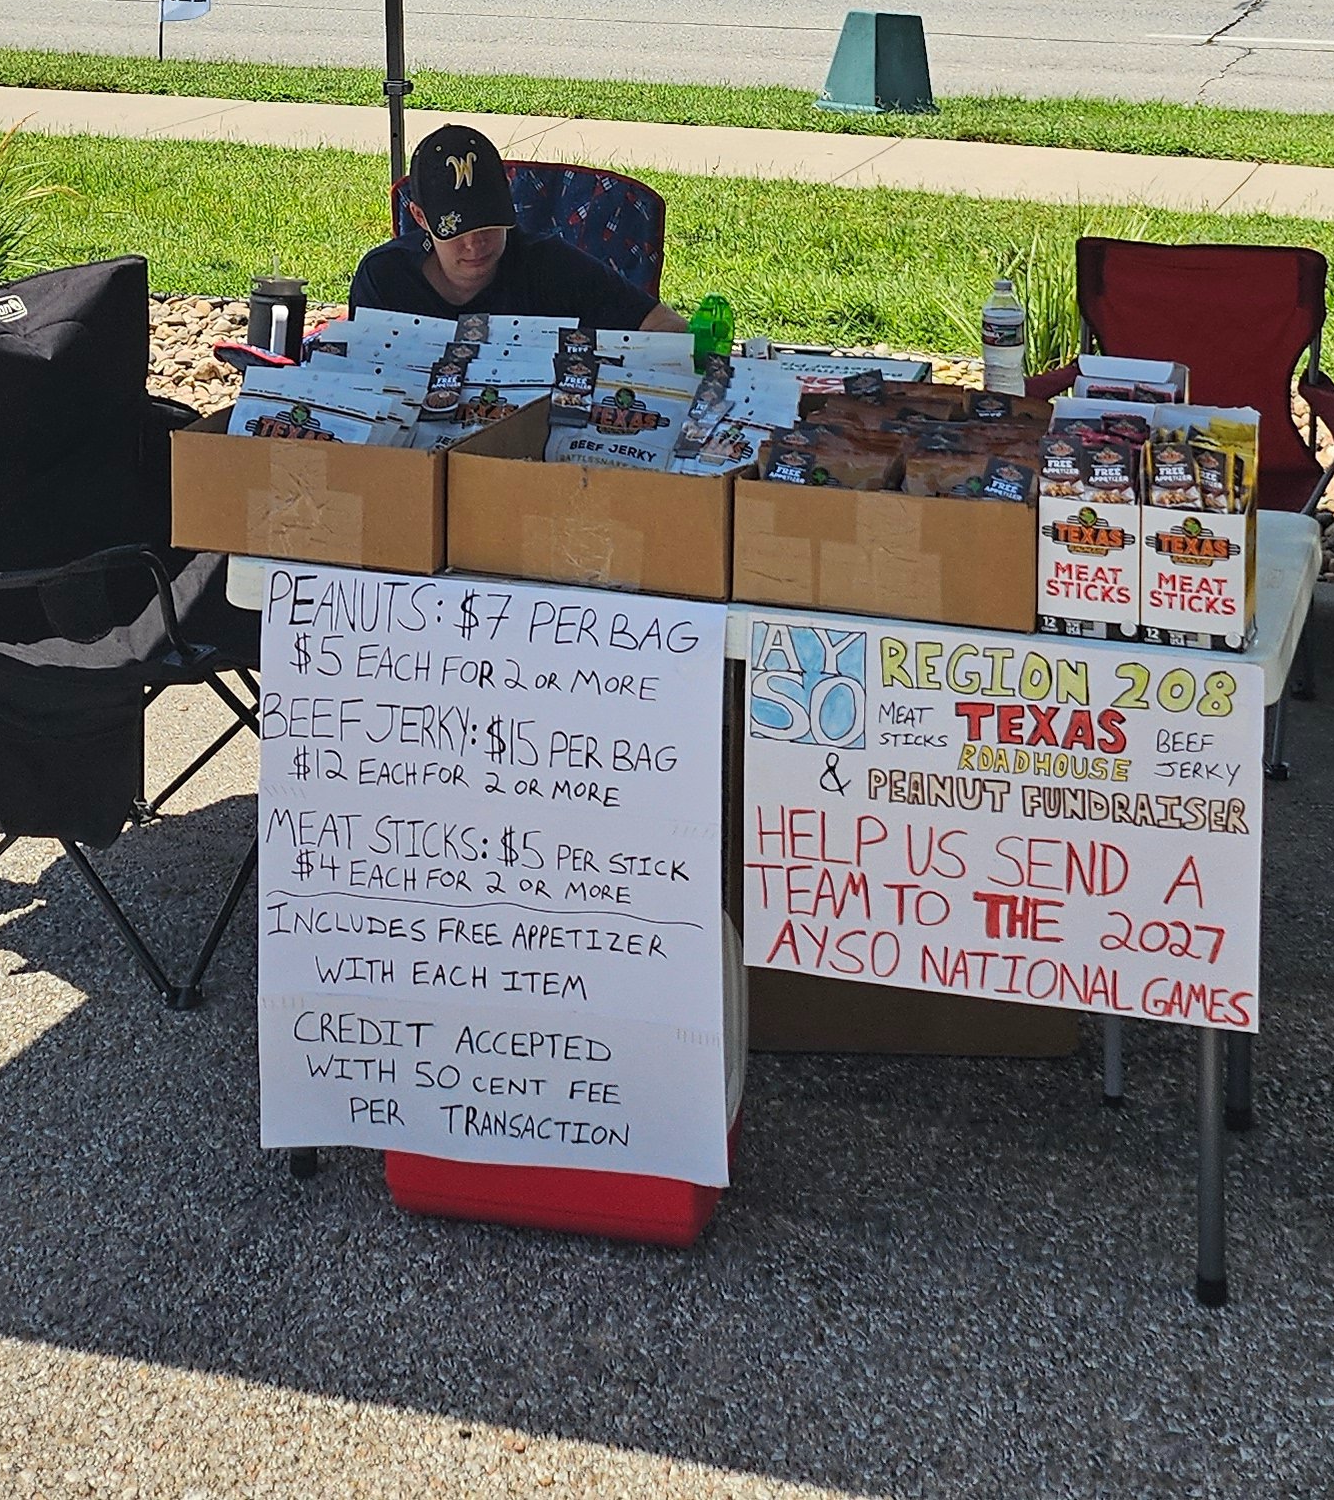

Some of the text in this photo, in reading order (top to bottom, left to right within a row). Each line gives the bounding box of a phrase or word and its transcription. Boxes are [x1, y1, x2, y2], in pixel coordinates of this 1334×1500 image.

[445, 151, 478, 190] W
[569, 440, 657, 463] BEEF JERKY
[1047, 459, 1073, 469] FREE
[776, 466, 802, 478] FREE
[992, 480, 1019, 494] FREE
[1042, 466, 1079, 476] APPETIZER
[1088, 474, 1129, 484] APPETIZER
[1094, 467, 1122, 477] FREE
[1154, 473, 1193, 483] APPETIZER
[1159, 466, 1185, 476] FREE
[1056, 523, 1123, 547] TEXAS
[1159, 534, 1229, 557] TEXAS
[1054, 561, 1123, 585] MEAT
[1157, 571, 1228, 596] MEAT
[1046, 579, 1131, 604] STICKS
[1149, 589, 1236, 616] STICKS
[267, 570, 700, 653] PEANUTS: $7 PER BAG
[1043, 616, 1056, 627] 12
[754, 621, 866, 675] AY
[1146, 627, 1159, 638] 12
[288, 632, 660, 701] $5 EACH FOR 2 OR MORE
[878, 636, 1238, 718] REGION 208
[750, 671, 866, 749] SO
[877, 701, 935, 726] MEAT
[260, 692, 679, 773] BEEF JERKY: $15 PER BAG
[877, 730, 949, 749] STICKS
[954, 701, 1128, 755] TEXAS
[1155, 728, 1215, 754] BEEF
[287, 746, 621, 807] $12 EACH FOR 2 OR MORE
[957, 743, 1133, 783] ROADHOUSE
[1152, 761, 1242, 788] JERKY
[819, 751, 1250, 837] & PEANUT FUNDRAISER
[265, 808, 691, 882] MEAT STICKS: $5 PER STICK
[755, 805, 1206, 910] HELP US SEND A
[290, 849, 633, 904] $4 EACH FOR 2 OR MORE
[266, 902, 668, 959] INCLUDES FREE APPETIZER
[744, 862, 1226, 966] TEAM TO THE 2027
[314, 956, 588, 1001] WITH EACH ITEM
[765, 919, 1254, 1028] AYSO NATIONAL GAMES
[292, 1010, 612, 1063] CREDIT ACCEPTED
[305, 1053, 623, 1106] WITH 50 CENT FEE
[349, 1097, 631, 1148] PER TRANSACTION
